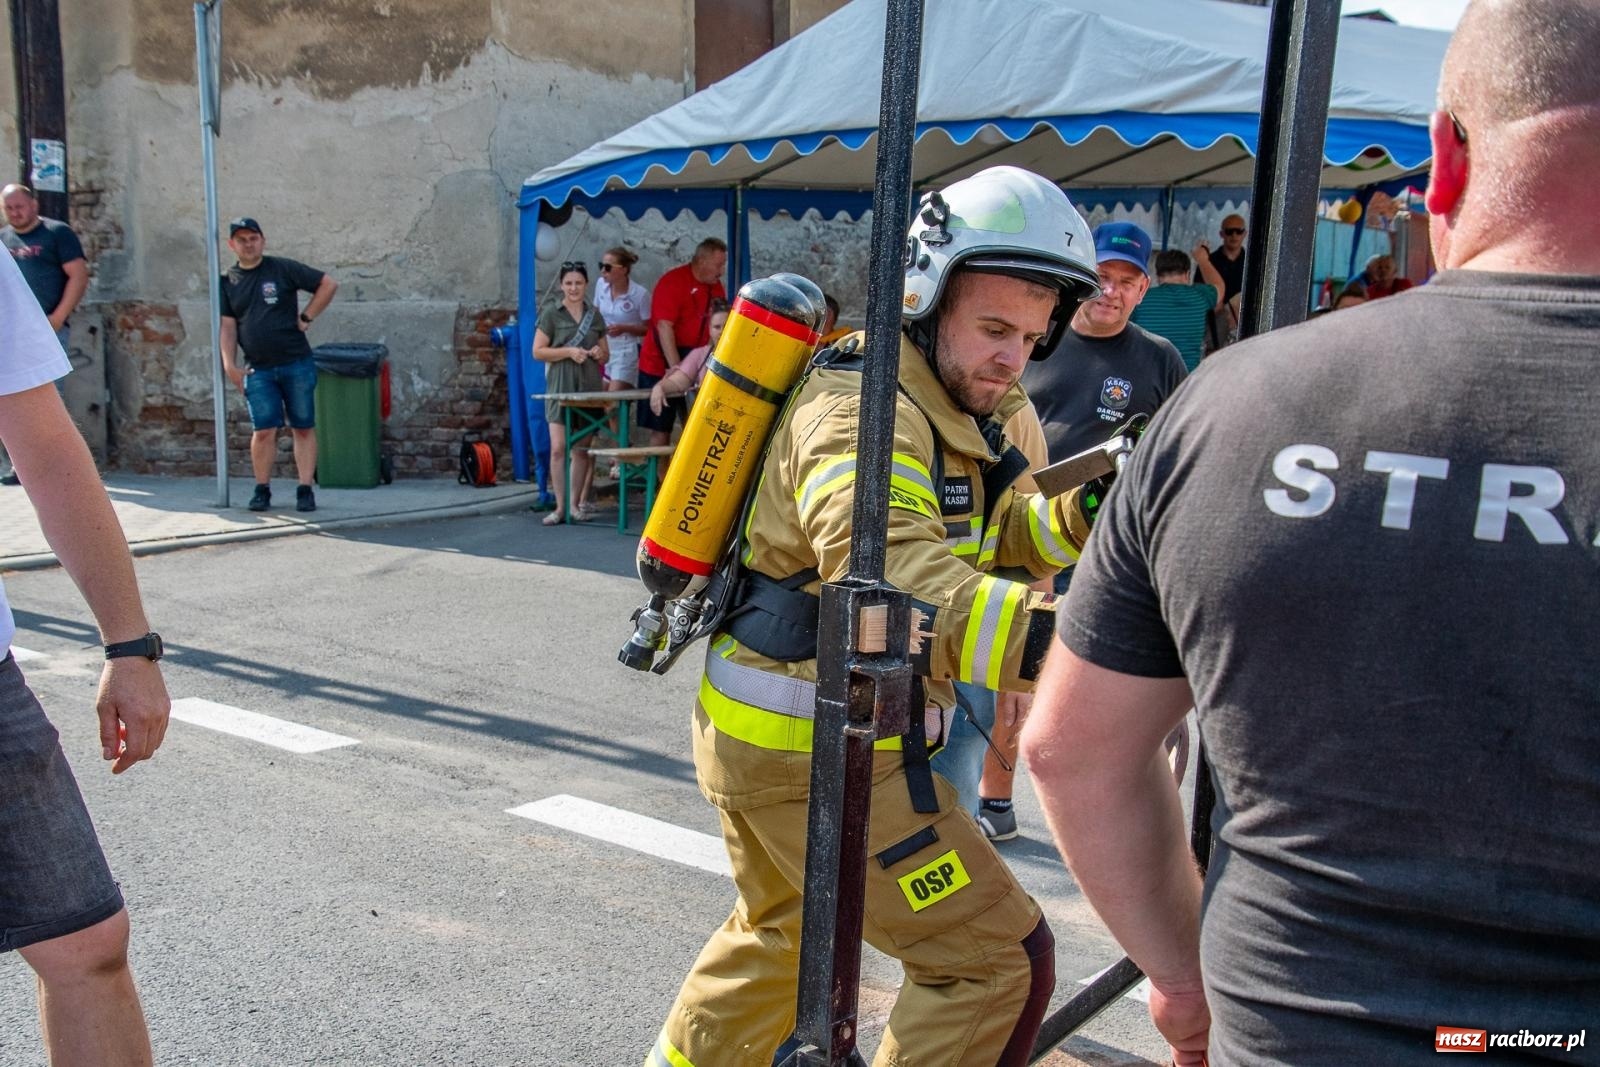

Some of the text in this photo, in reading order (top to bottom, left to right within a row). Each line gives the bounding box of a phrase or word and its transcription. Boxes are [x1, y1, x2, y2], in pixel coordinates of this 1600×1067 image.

[1064, 231, 1074, 247] 7
[1096, 406, 1126, 419] DARIUSZ
[677, 420, 736, 535] POWIETRZE
[945, 485, 969, 494] PATRYK
[1263, 443, 1600, 547] STR
[910, 862, 955, 901] OSP
